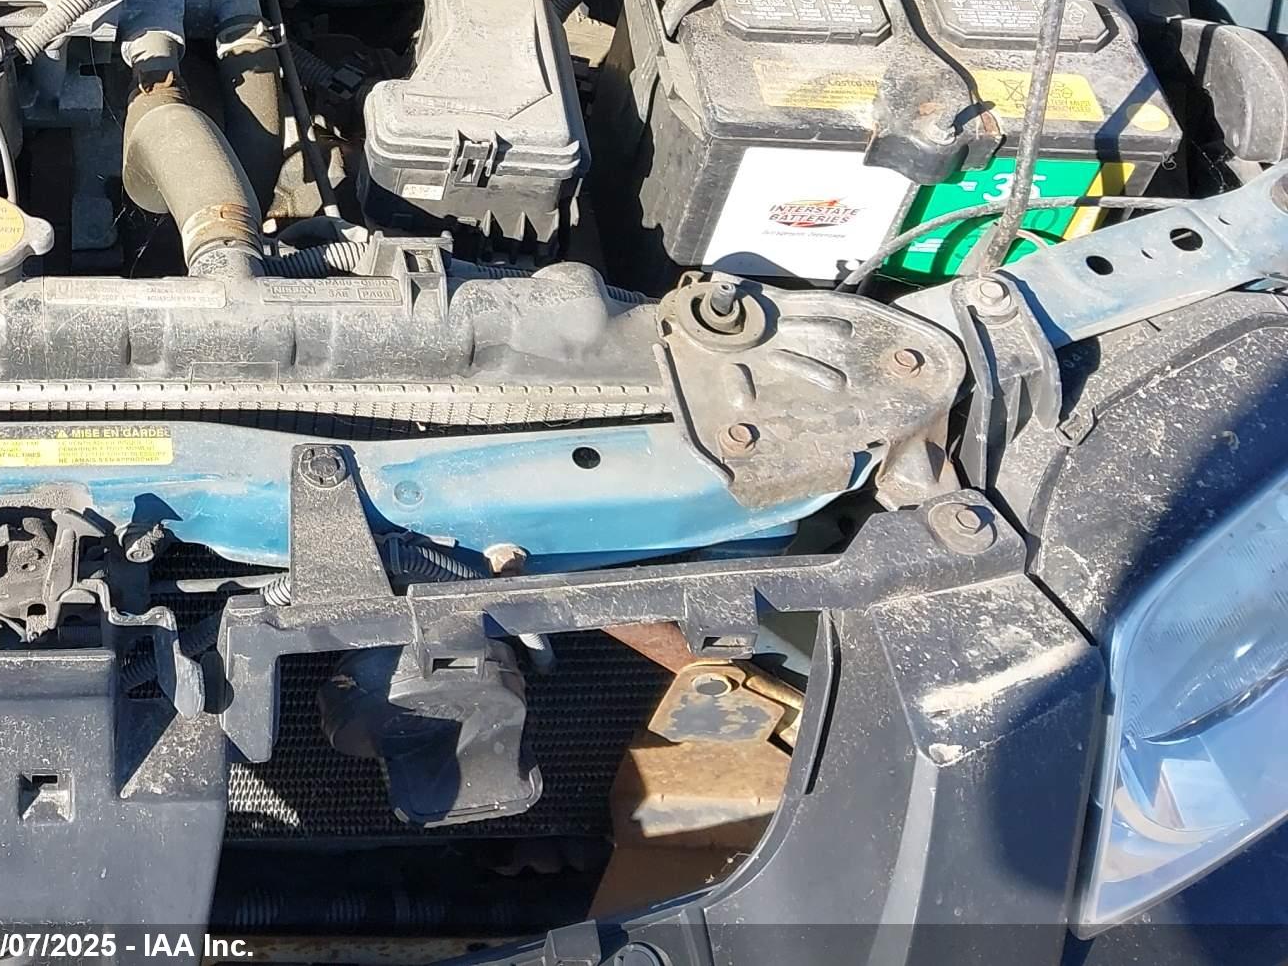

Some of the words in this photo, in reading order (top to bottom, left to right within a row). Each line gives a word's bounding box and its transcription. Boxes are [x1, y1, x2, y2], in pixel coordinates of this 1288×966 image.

[769, 204, 861, 216] INTERSTATE
[768, 213, 851, 224] BATTERIES
[71, 429, 100, 438] MISE
[103, 429, 120, 438] EN
